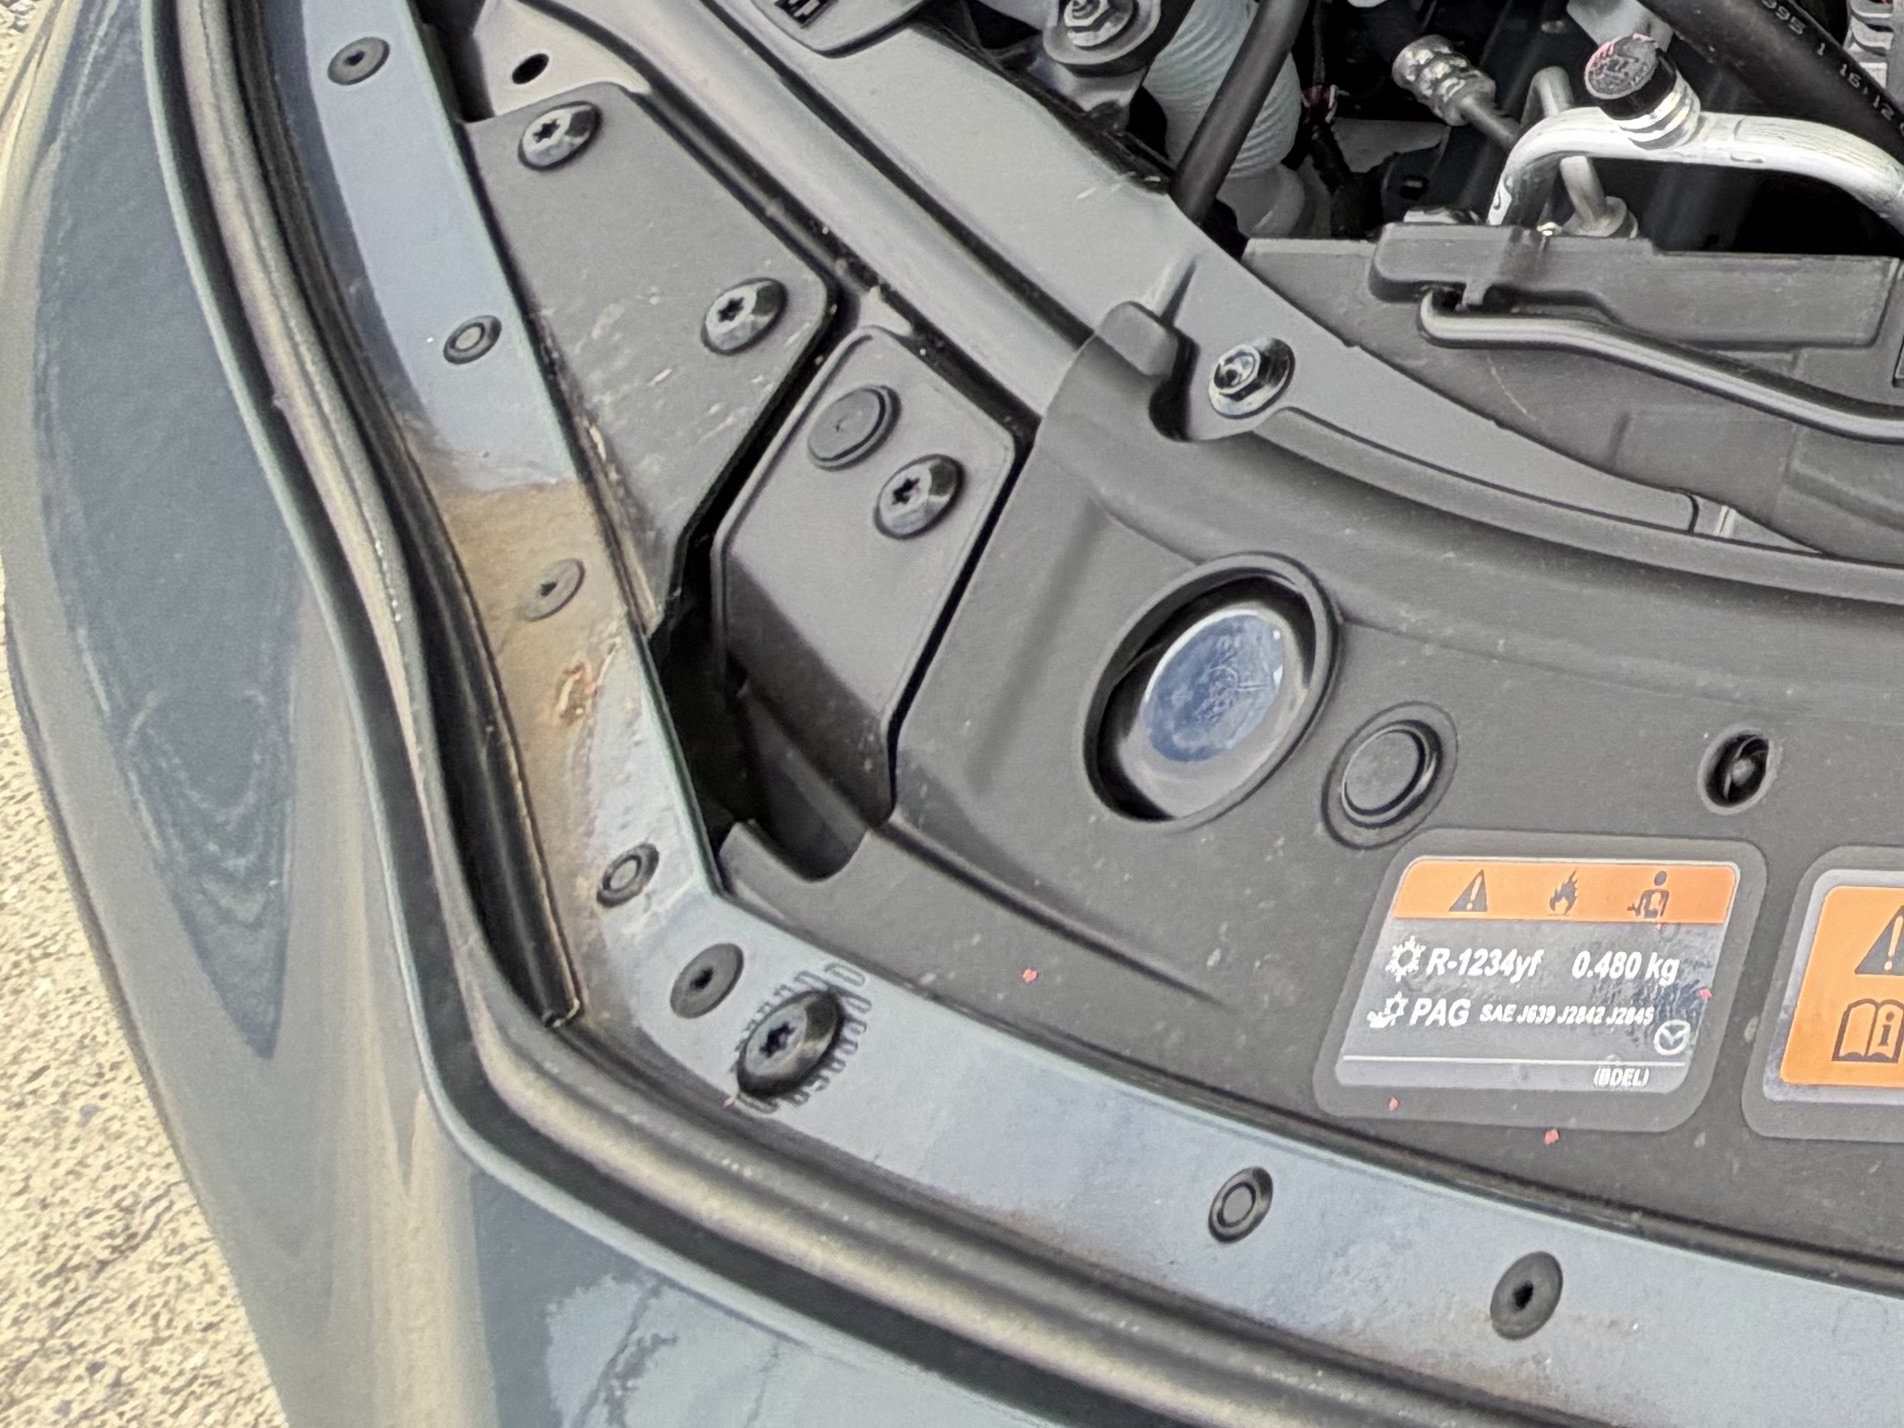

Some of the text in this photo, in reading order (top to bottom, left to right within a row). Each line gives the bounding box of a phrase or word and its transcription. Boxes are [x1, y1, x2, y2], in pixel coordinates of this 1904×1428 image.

[1425, 947, 1681, 986] R-1234yf 0.480 kg
[1408, 997, 1472, 1028] PAG
[1479, 1003, 1517, 1023] SAE
[1517, 1004, 1557, 1025] J639
[1557, 1005, 1606, 1025] J2842
